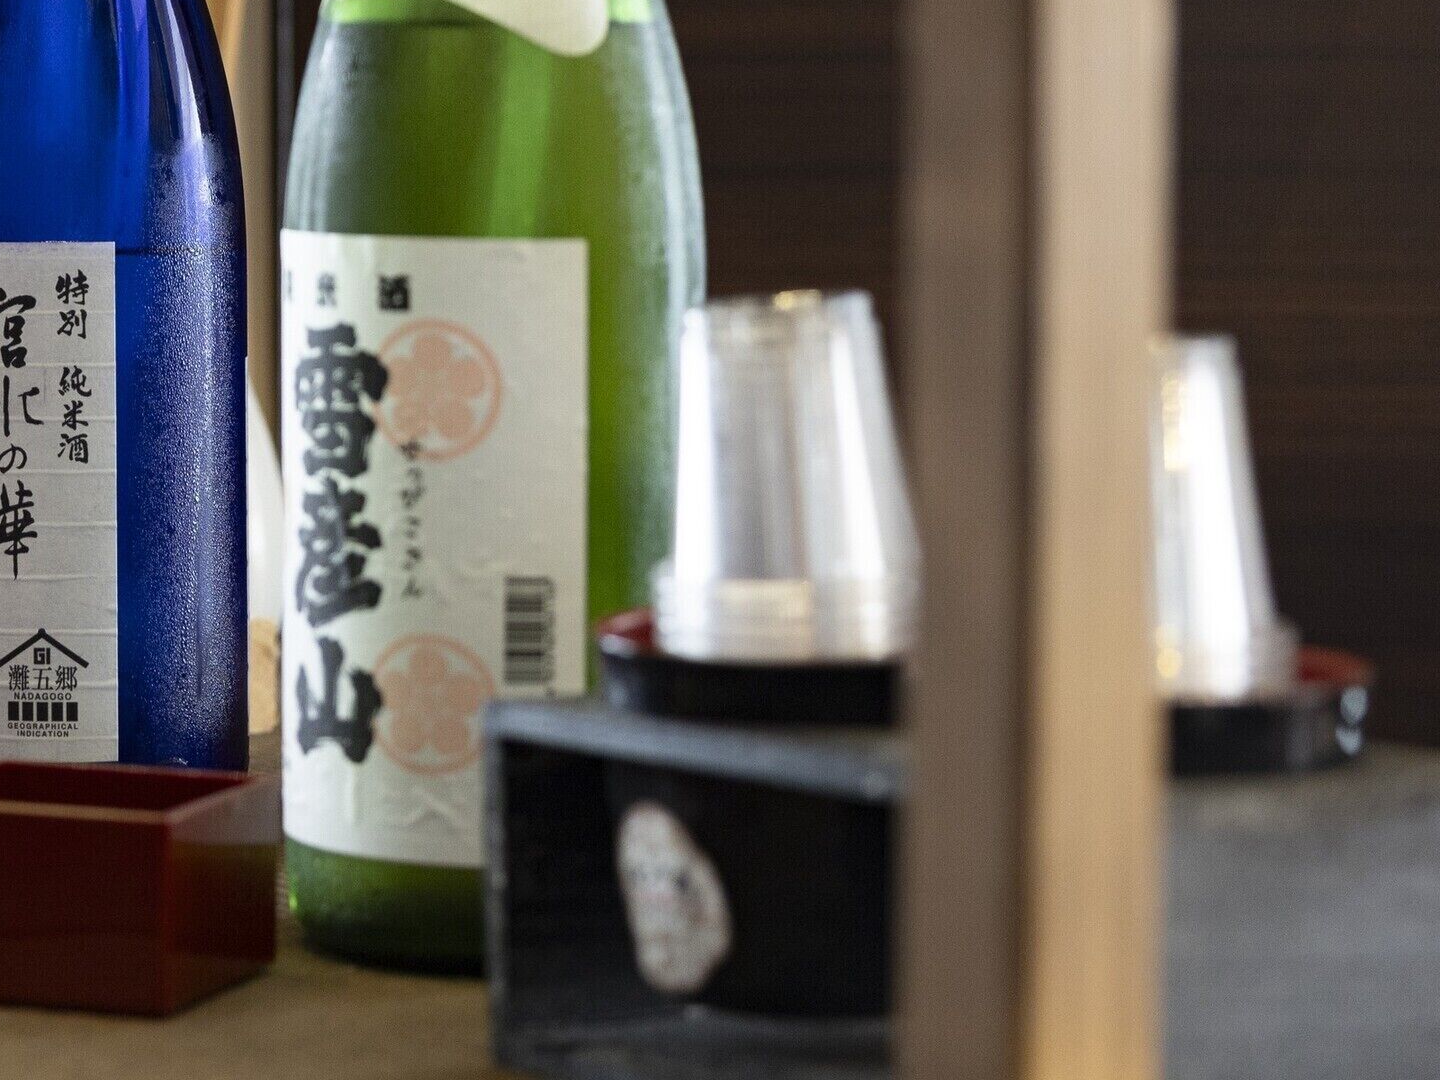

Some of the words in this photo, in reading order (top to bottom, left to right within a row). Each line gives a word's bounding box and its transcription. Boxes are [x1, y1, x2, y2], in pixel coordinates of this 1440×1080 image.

[55, 269, 89, 340] 特別
[58, 366, 92, 465] 純米酒
[34, 647, 51, 665] GI
[9, 665, 77, 692] 灘五郷
[13, 692, 73, 701] NADAGOGO
[7, 722, 79, 731] GEOGRAPHICAL
[16, 730, 70, 738] INDICATION
